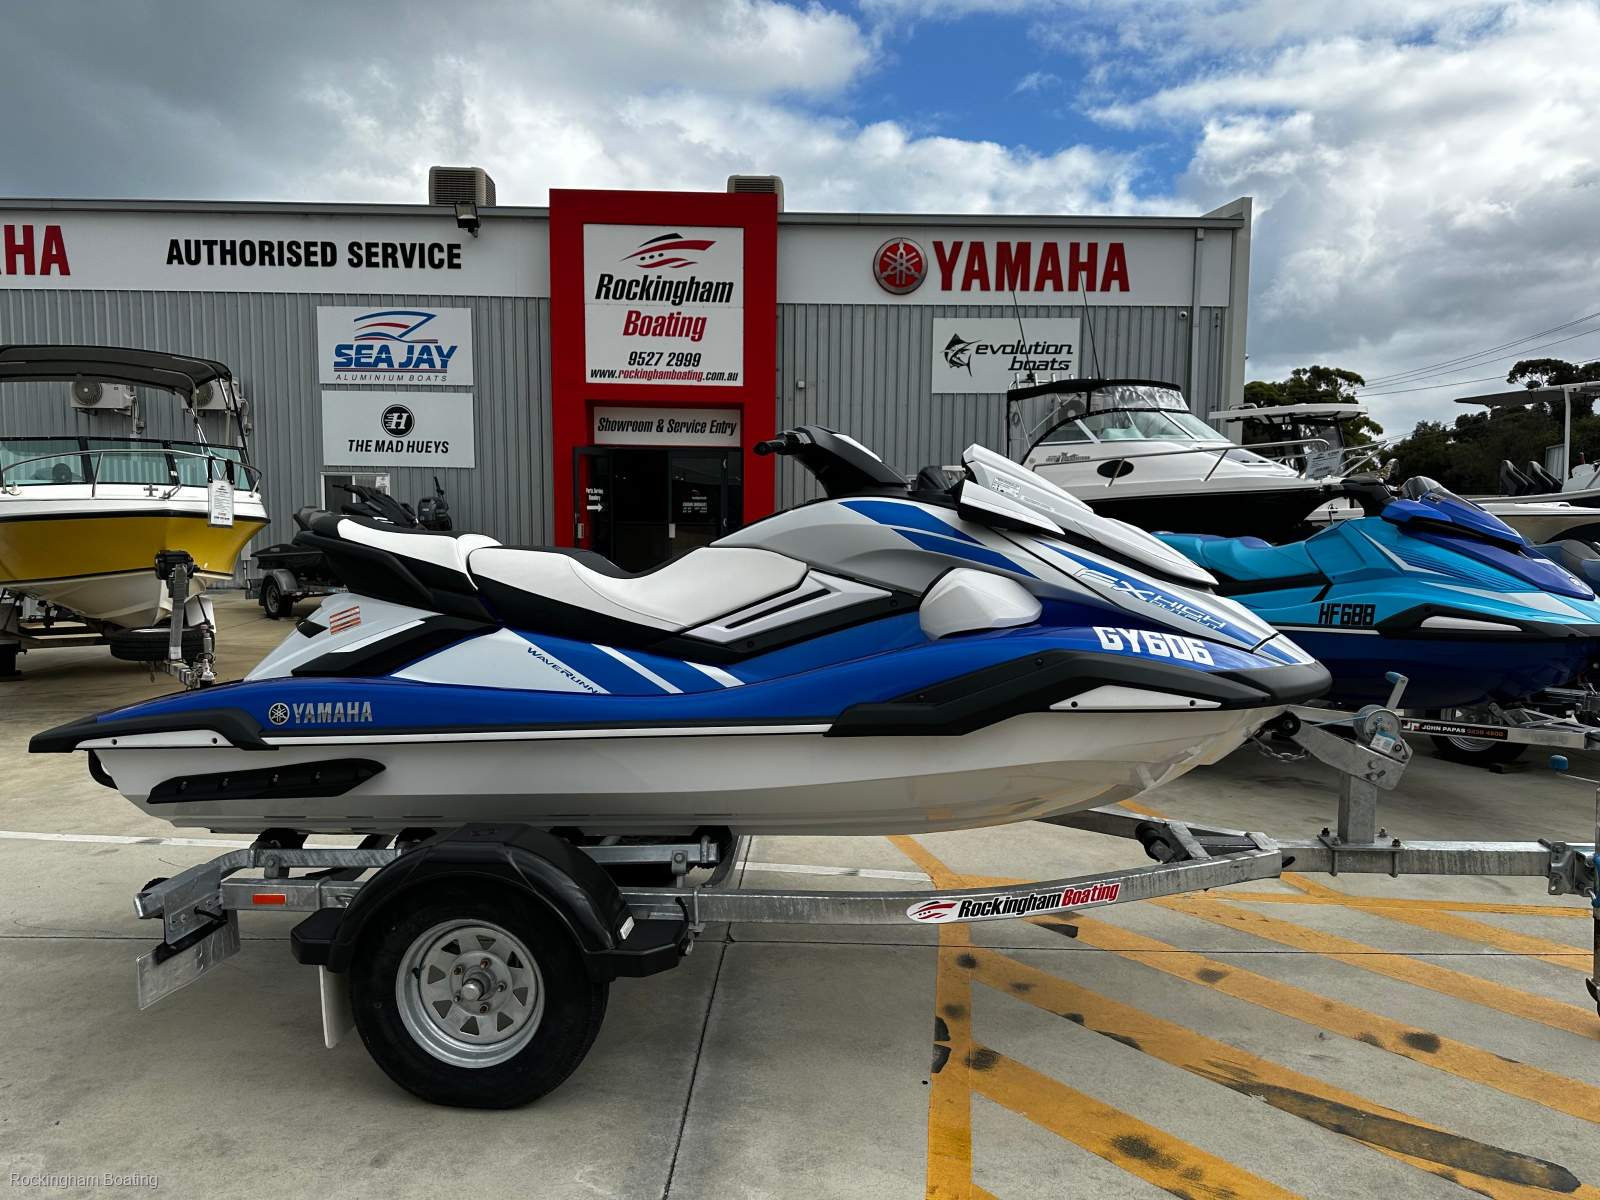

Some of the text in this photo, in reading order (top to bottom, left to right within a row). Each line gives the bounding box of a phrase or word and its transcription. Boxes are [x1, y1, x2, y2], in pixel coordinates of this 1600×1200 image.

[0, 225, 71, 276] HA
[166, 239, 462, 269] AUTHORISED SERVICE
[932, 240, 1131, 292] YAMAHA
[595, 273, 734, 306] Rockingham
[623, 310, 707, 342] Boating
[333, 344, 458, 369] SEA JAY
[975, 340, 1074, 355] evolution
[628, 351, 702, 368] 9527 2999
[1008, 356, 1072, 371] boats
[335, 374, 404, 382] ALUMINIUM
[590, 368, 738, 382] www.rockinghamboating.com.au
[598, 417, 737, 437] Showroom & Service Entry
[348, 440, 450, 454] THE MAD HUEYS
[1073, 568, 1154, 601] FX
[1318, 603, 1376, 625] HF688
[1093, 626, 1215, 666] GY606
[292, 701, 373, 724] YAMAHA
[1442, 726, 1466, 734] PAPAS
[958, 883, 1121, 918] Rockingham Boating
